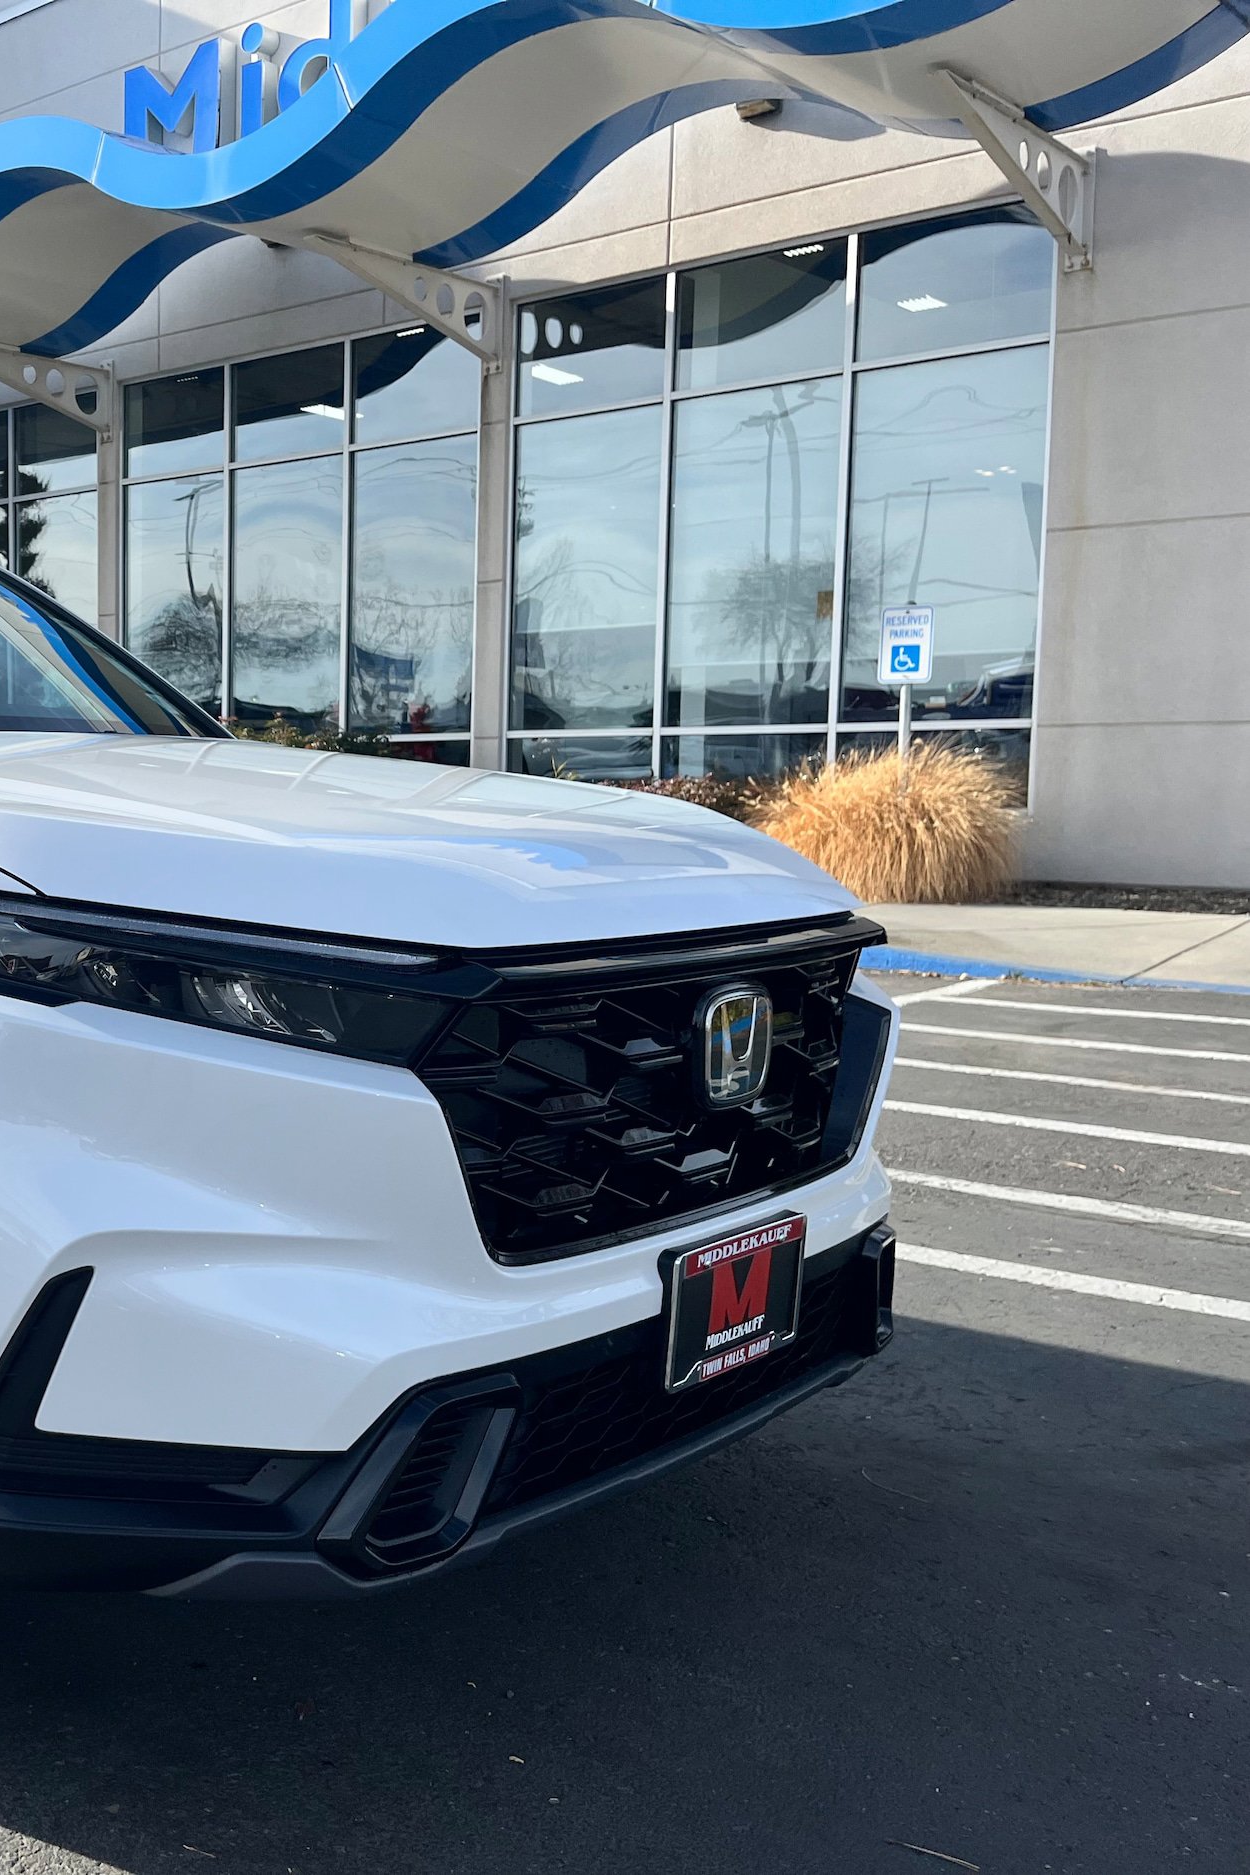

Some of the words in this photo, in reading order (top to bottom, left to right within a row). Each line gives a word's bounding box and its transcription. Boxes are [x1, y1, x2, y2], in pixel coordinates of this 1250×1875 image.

[885, 614, 929, 626] RESERVED
[890, 628, 924, 639] PARKING
[697, 1223, 792, 1268] MIDDLEKAUFF
[708, 1248, 773, 1335] M
[704, 1314, 766, 1350] MIDDLEKAUFF
[701, 1356, 724, 1378] TWIN
[723, 1347, 746, 1364] FALLS,
[747, 1336, 771, 1358] IDAHO
